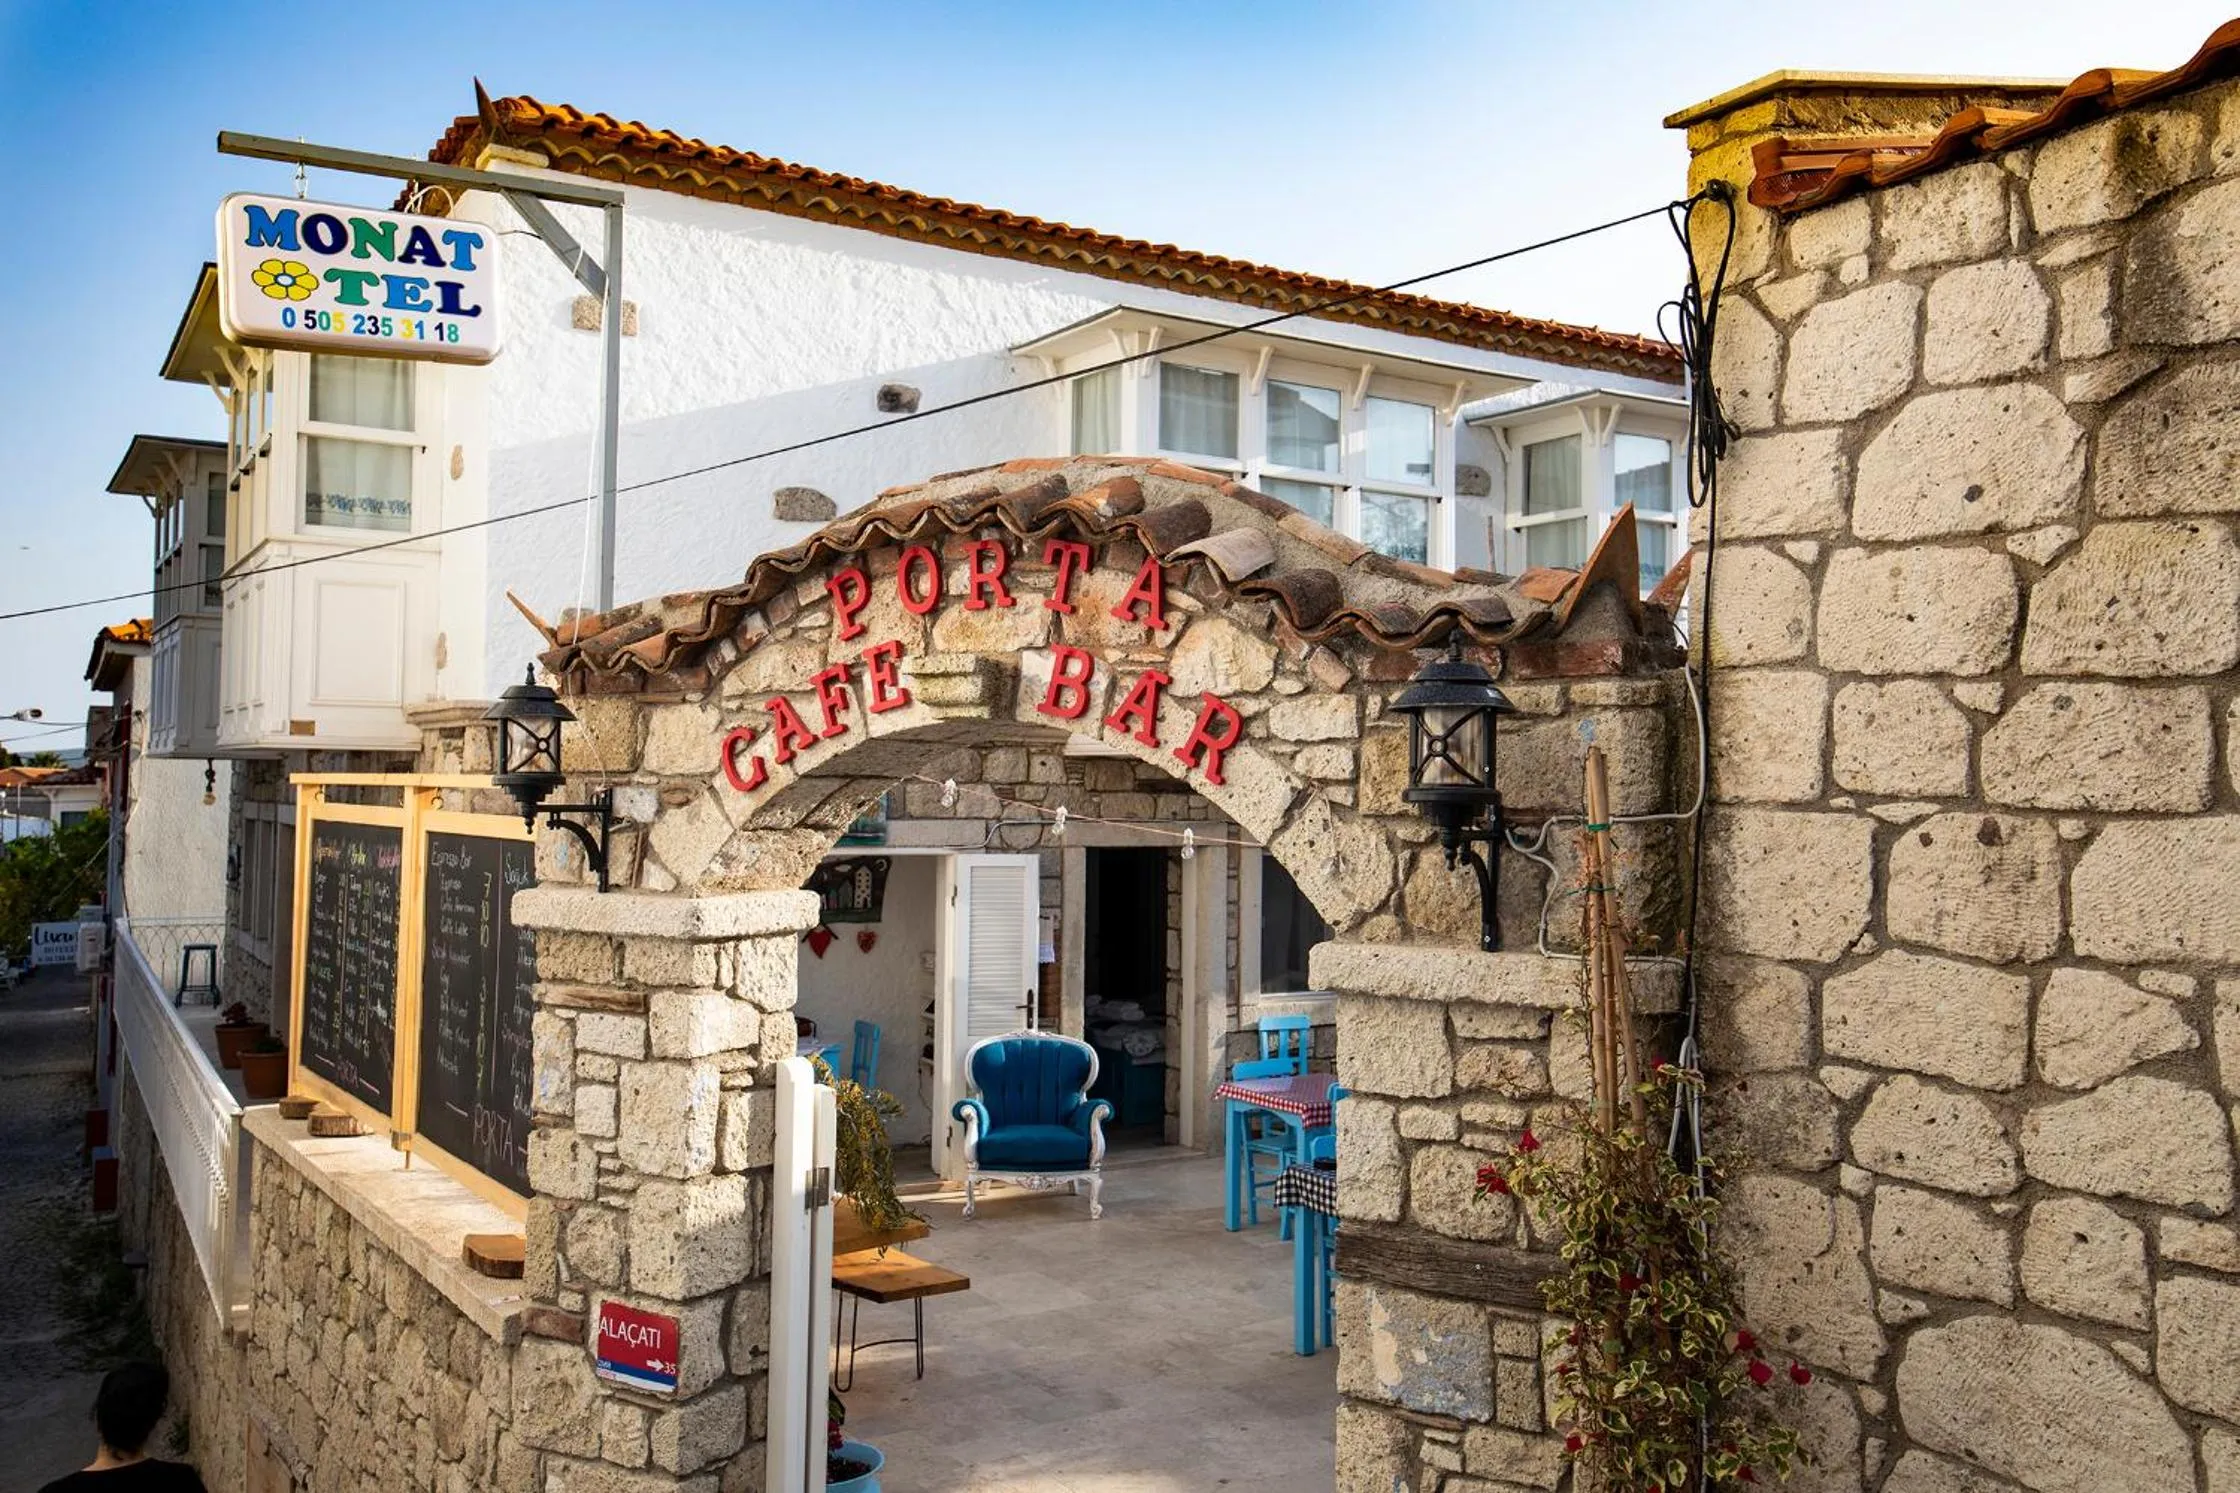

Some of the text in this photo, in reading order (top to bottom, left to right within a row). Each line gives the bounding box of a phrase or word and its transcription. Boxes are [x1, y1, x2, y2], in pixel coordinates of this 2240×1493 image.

[243, 204, 484, 271] MONAT
[282, 307, 459, 343] 0 505 235 31 18
[825, 538, 1171, 642] PORTA
[721, 639, 1245, 792] CAFE BAR
[598, 1316, 661, 1350] ALAÇATI
